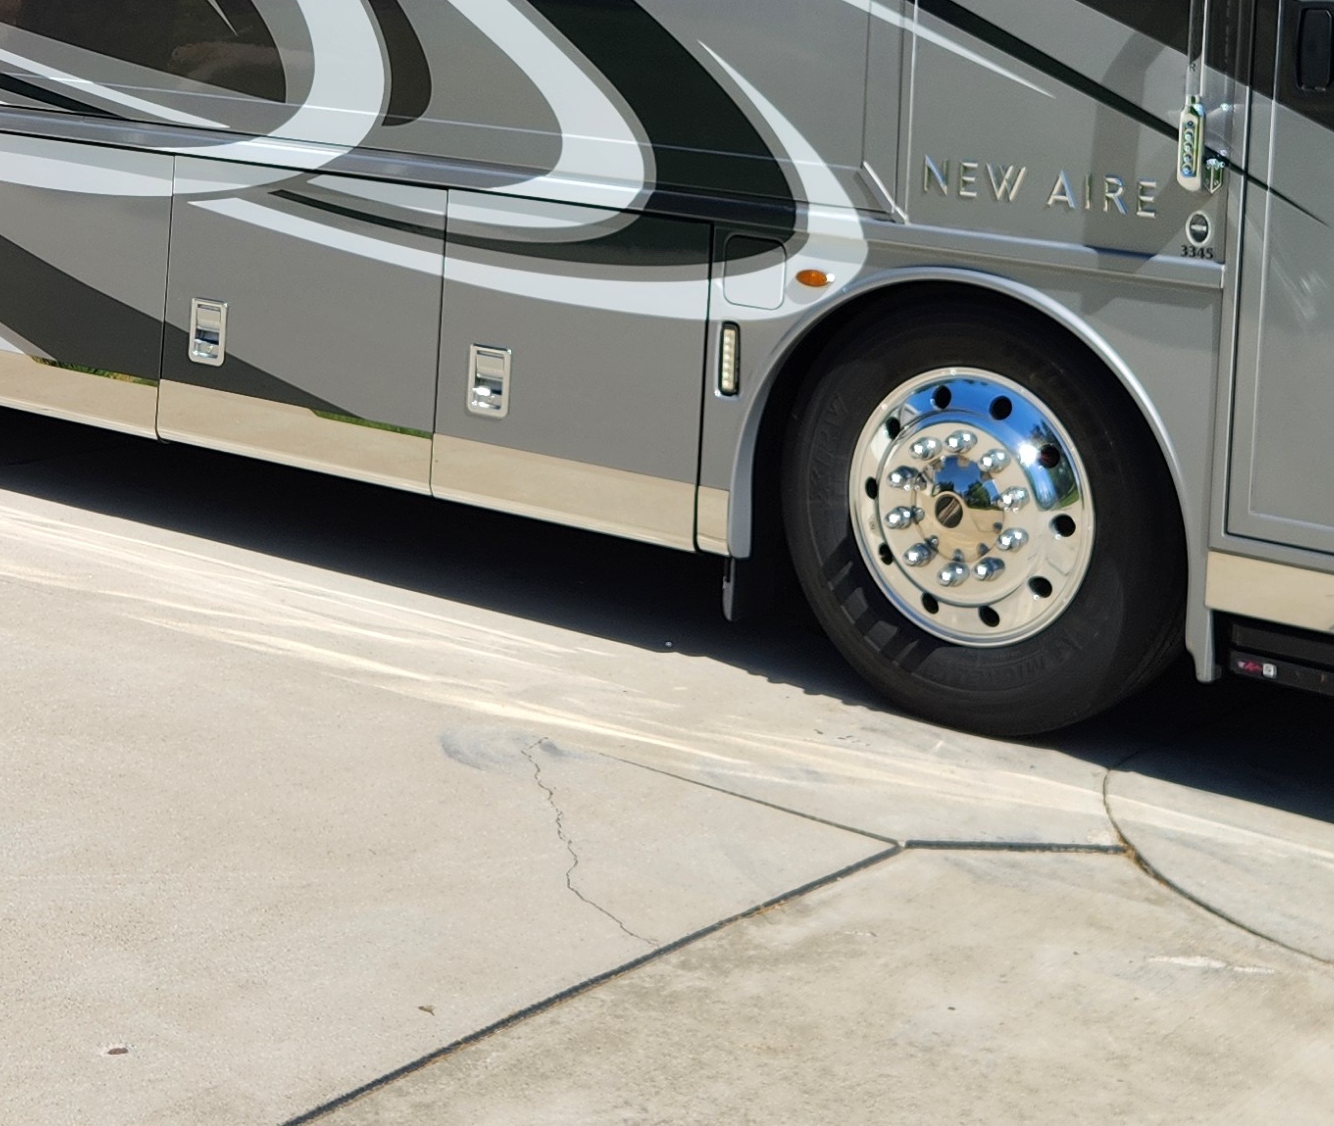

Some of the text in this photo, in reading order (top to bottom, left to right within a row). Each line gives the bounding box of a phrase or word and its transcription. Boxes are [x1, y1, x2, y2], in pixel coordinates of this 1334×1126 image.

[923, 154, 1157, 219] NEW AIRE
[1180, 244, 1214, 260] 3345
